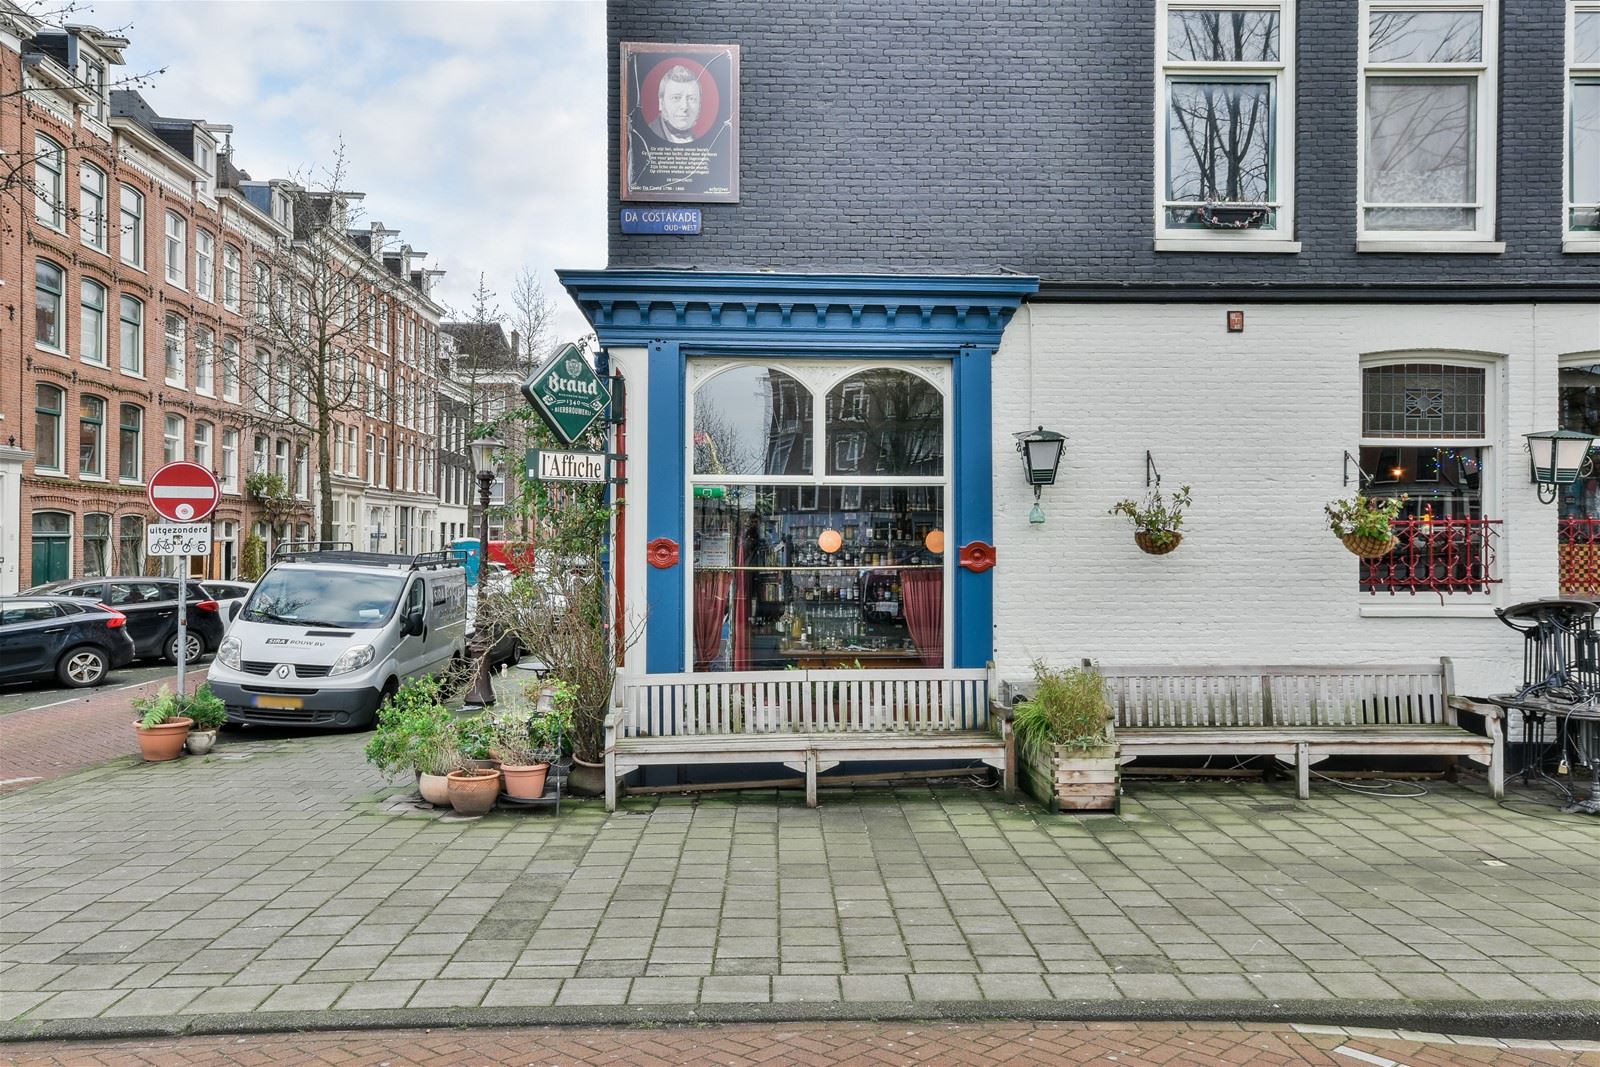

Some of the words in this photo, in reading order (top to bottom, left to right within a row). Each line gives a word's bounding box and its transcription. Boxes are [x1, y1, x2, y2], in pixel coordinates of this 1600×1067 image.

[625, 211, 638, 222] DA
[642, 211, 697, 222] COSTAKADE
[548, 371, 598, 395] Brand
[149, 526, 208, 536] uitgezonderd
